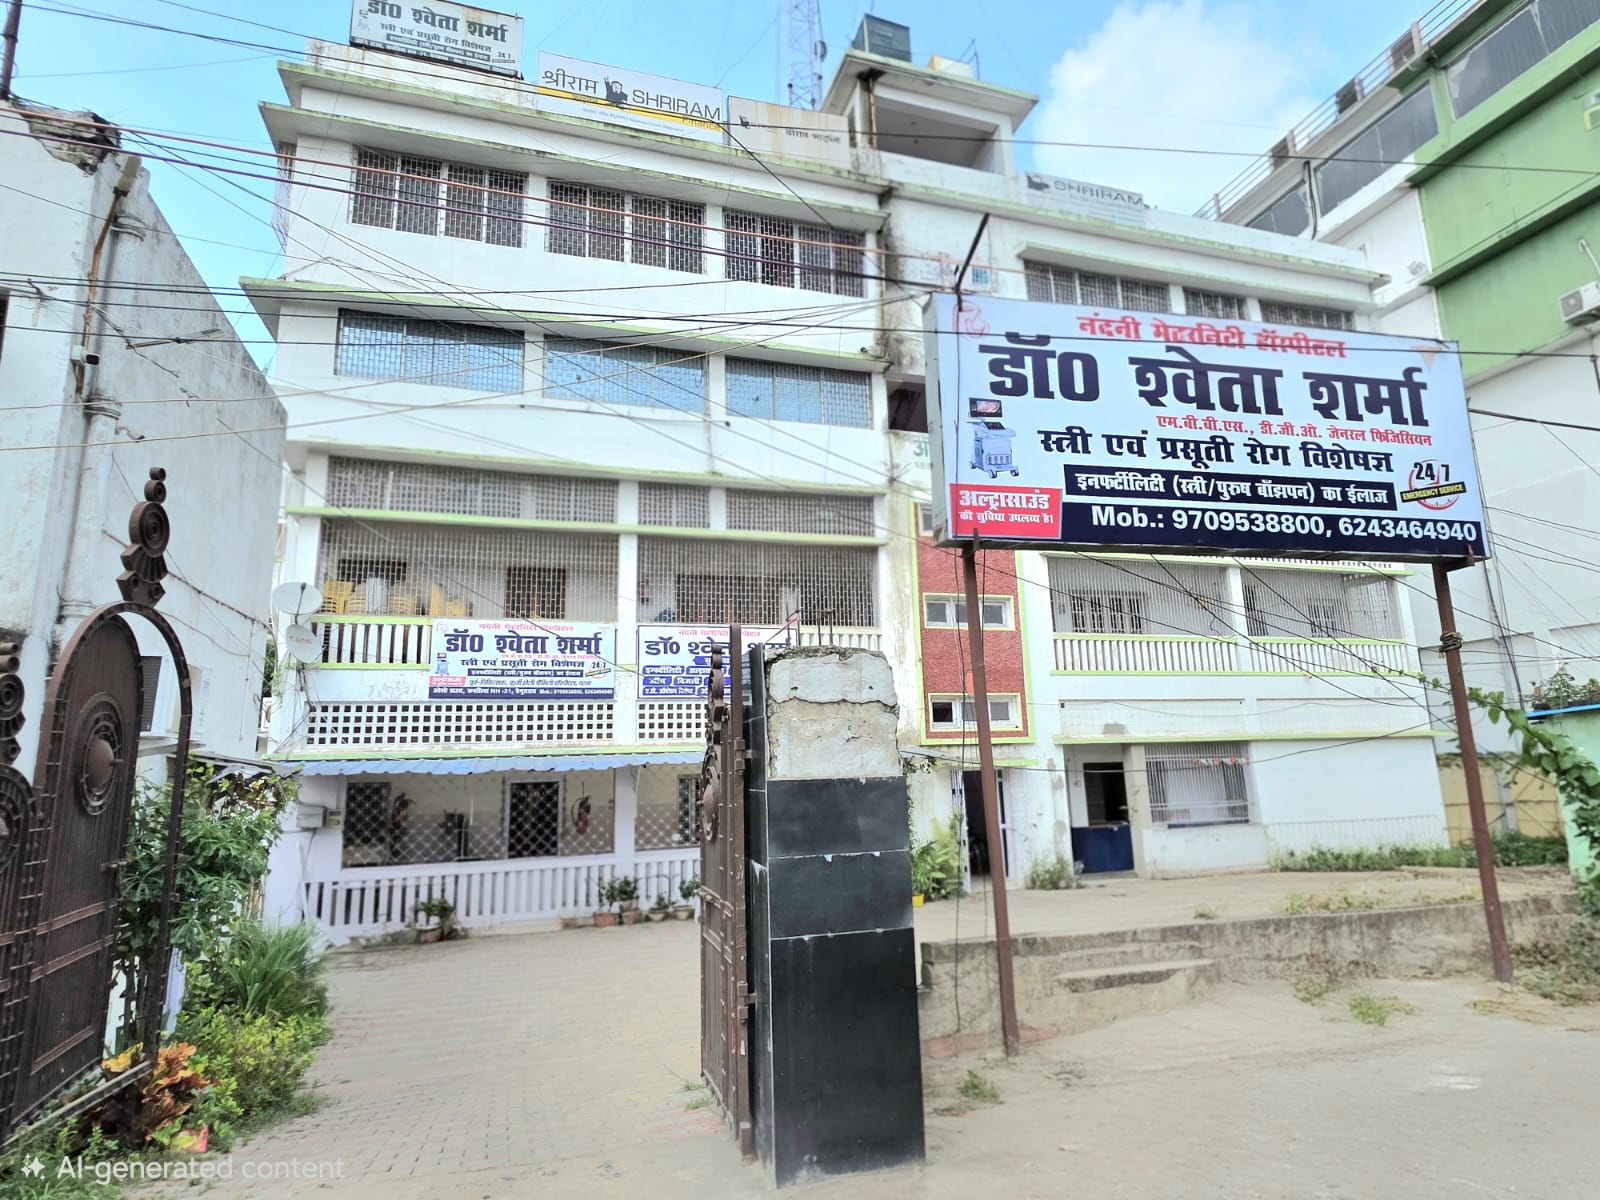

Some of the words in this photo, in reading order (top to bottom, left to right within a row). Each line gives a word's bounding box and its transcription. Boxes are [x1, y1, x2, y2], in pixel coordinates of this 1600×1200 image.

[411, 6, 461, 33] श्वेता
[466, 20, 509, 43] शर्मा
[542, 68, 600, 95] श्रीराम
[632, 89, 721, 121] SHRIRAM
[1054, 180, 1144, 206] SHRIRAM
[1128, 345, 1284, 417] श्वेता
[1303, 366, 1430, 428] शर्मा
[1037, 425, 1093, 455] स्त्री
[1102, 430, 1148, 458] एवं
[1157, 434, 1235, 470] प्रसूती
[1243, 437, 1291, 467] रोग
[1299, 440, 1394, 472] विशेषज्ञ
[1327, 425, 1367, 441] जेनरल
[1370, 427, 1432, 446] फिजिसियन
[959, 488, 1050, 512] अल्ट्रासाउंड
[1320, 486, 1343, 502] का
[1347, 484, 1389, 504] ईलाज
[1402, 486, 1438, 501] EMERGENCY
[1439, 484, 1465, 495] SERVICE
[959, 509, 974, 521] की
[1092, 505, 1165, 529] Mob.:
[1172, 509, 1333, 538] 9709538800,
[1338, 517, 1477, 542] 6243464940
[494, 629, 549, 653] श्वेता
[556, 632, 603, 655] शर्मा
